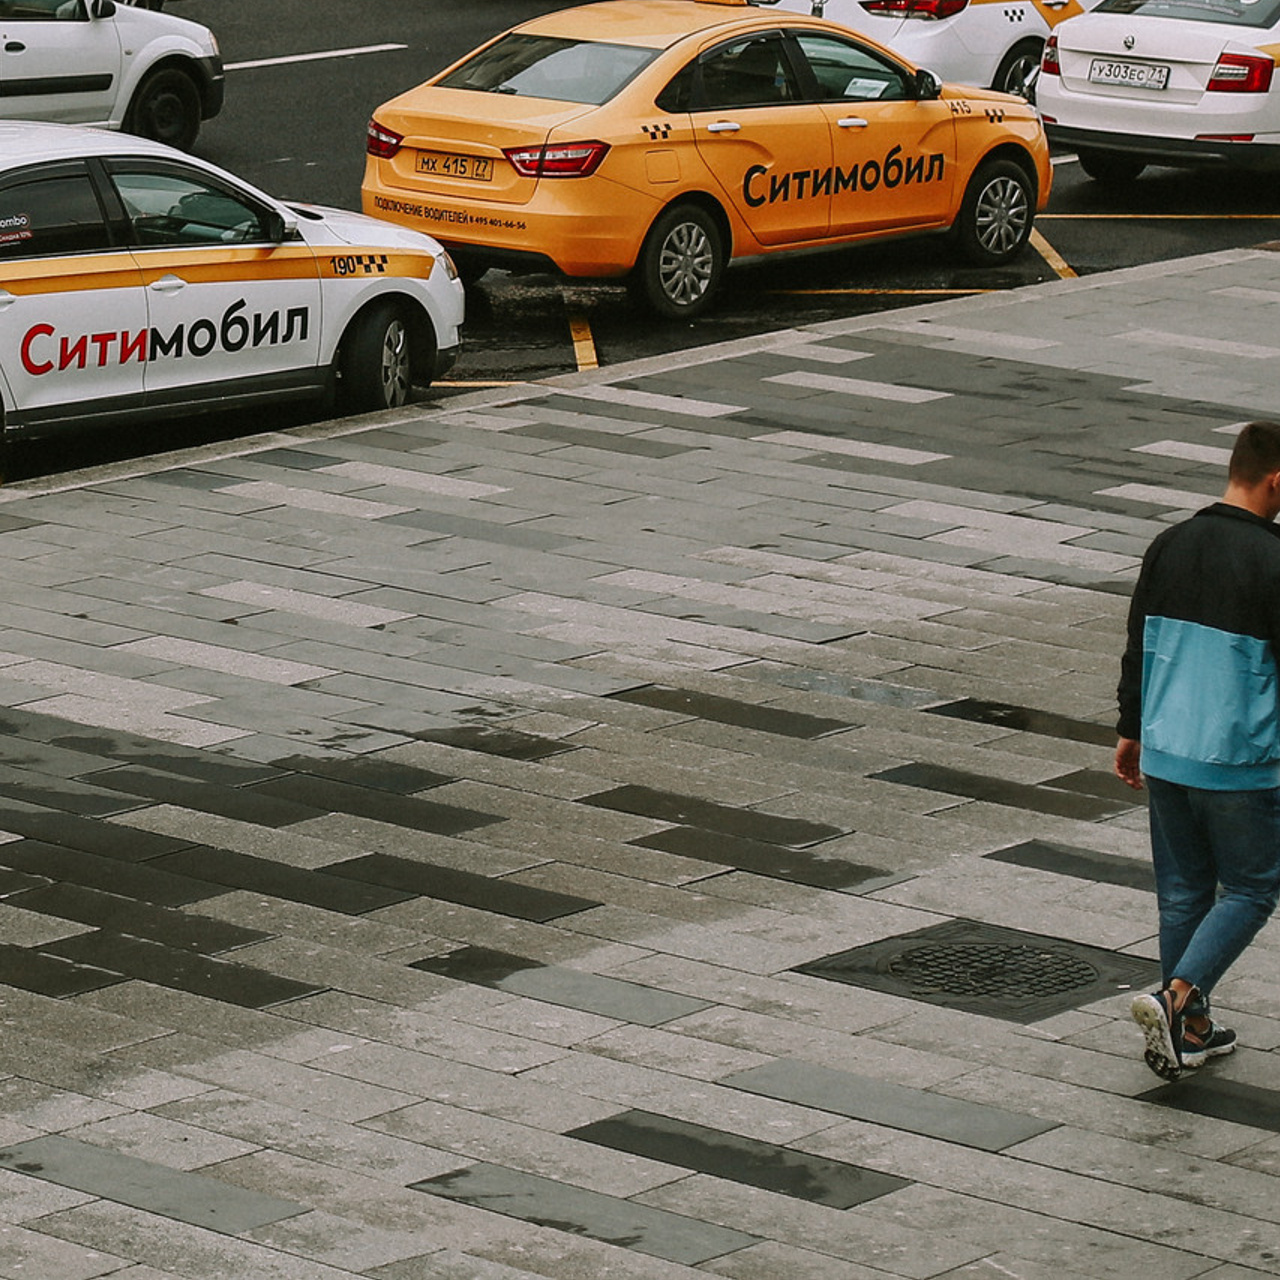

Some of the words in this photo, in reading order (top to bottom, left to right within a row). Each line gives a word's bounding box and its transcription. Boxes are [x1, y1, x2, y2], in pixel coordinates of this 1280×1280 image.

[950, 101, 972, 116] 415
[742, 144, 945, 208] Ситимобил
[330, 255, 356, 276] 190
[21, 298, 310, 376] Ситимобил
